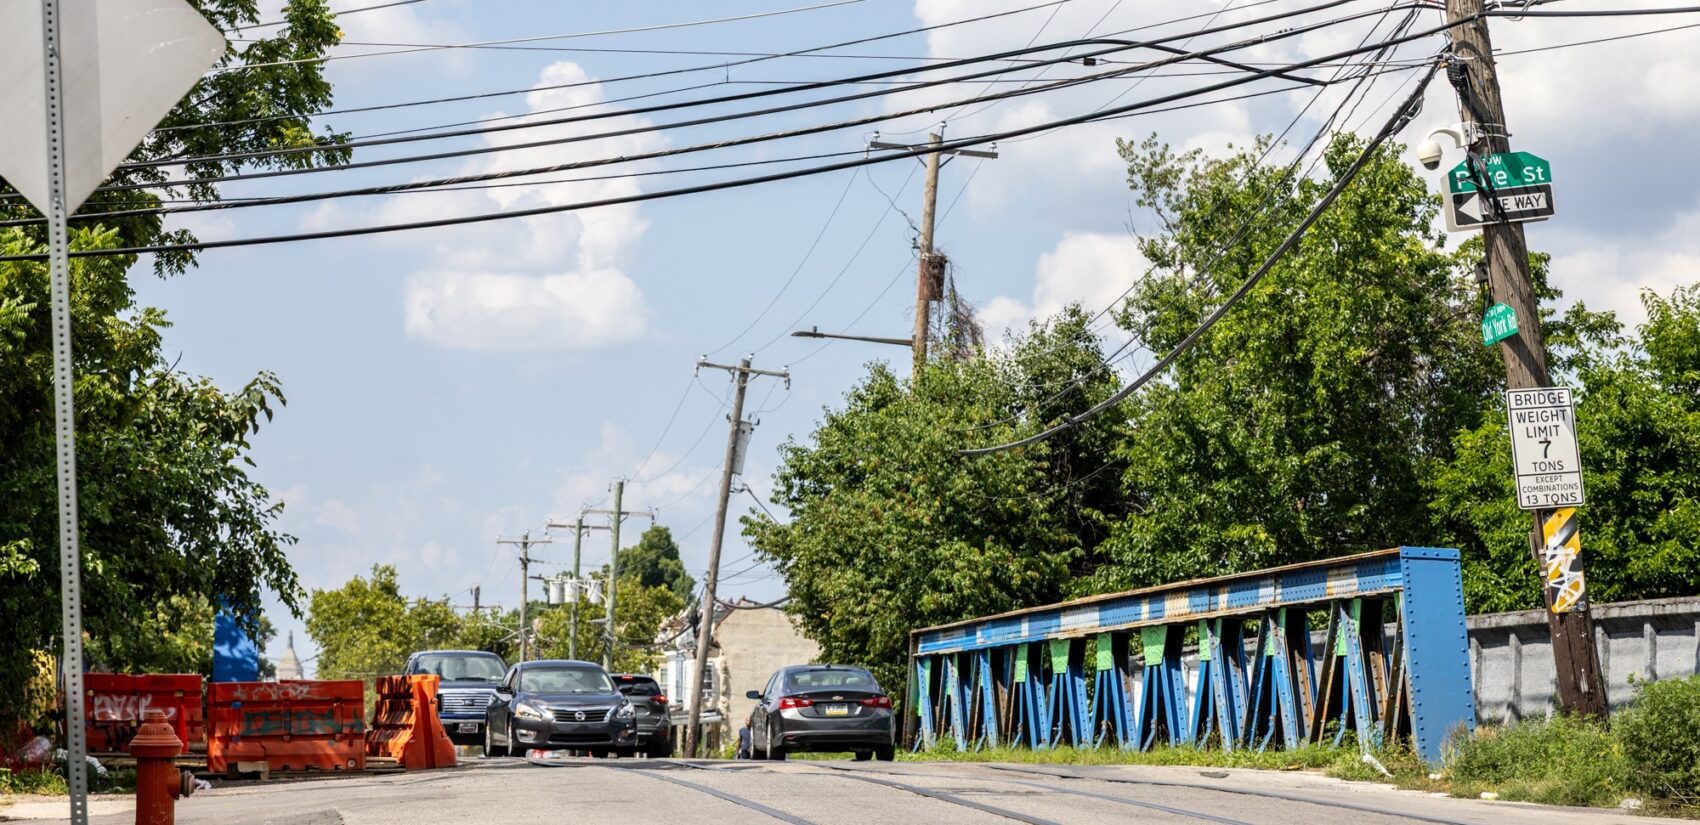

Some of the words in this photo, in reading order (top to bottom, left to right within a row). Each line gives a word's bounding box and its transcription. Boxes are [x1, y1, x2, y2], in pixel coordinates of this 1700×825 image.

[1523, 166, 1545, 182] St
[1514, 195, 1542, 209] WAY
[1482, 321, 1493, 341] Old
[1492, 316, 1507, 336] York
[1507, 312, 1517, 331] Rd
[1514, 391, 1565, 406] BRIDGE
[1515, 409, 1567, 424] WEIGHT
[1526, 425, 1560, 439] LIMIT
[1538, 440, 1551, 459] 7
[1531, 460, 1564, 472] TONS
[1535, 475, 1563, 484] EXCEPT
[1522, 482, 1579, 493] COMBINATIONS
[1526, 495, 1539, 505] 13
[1543, 492, 1577, 504] TONS
